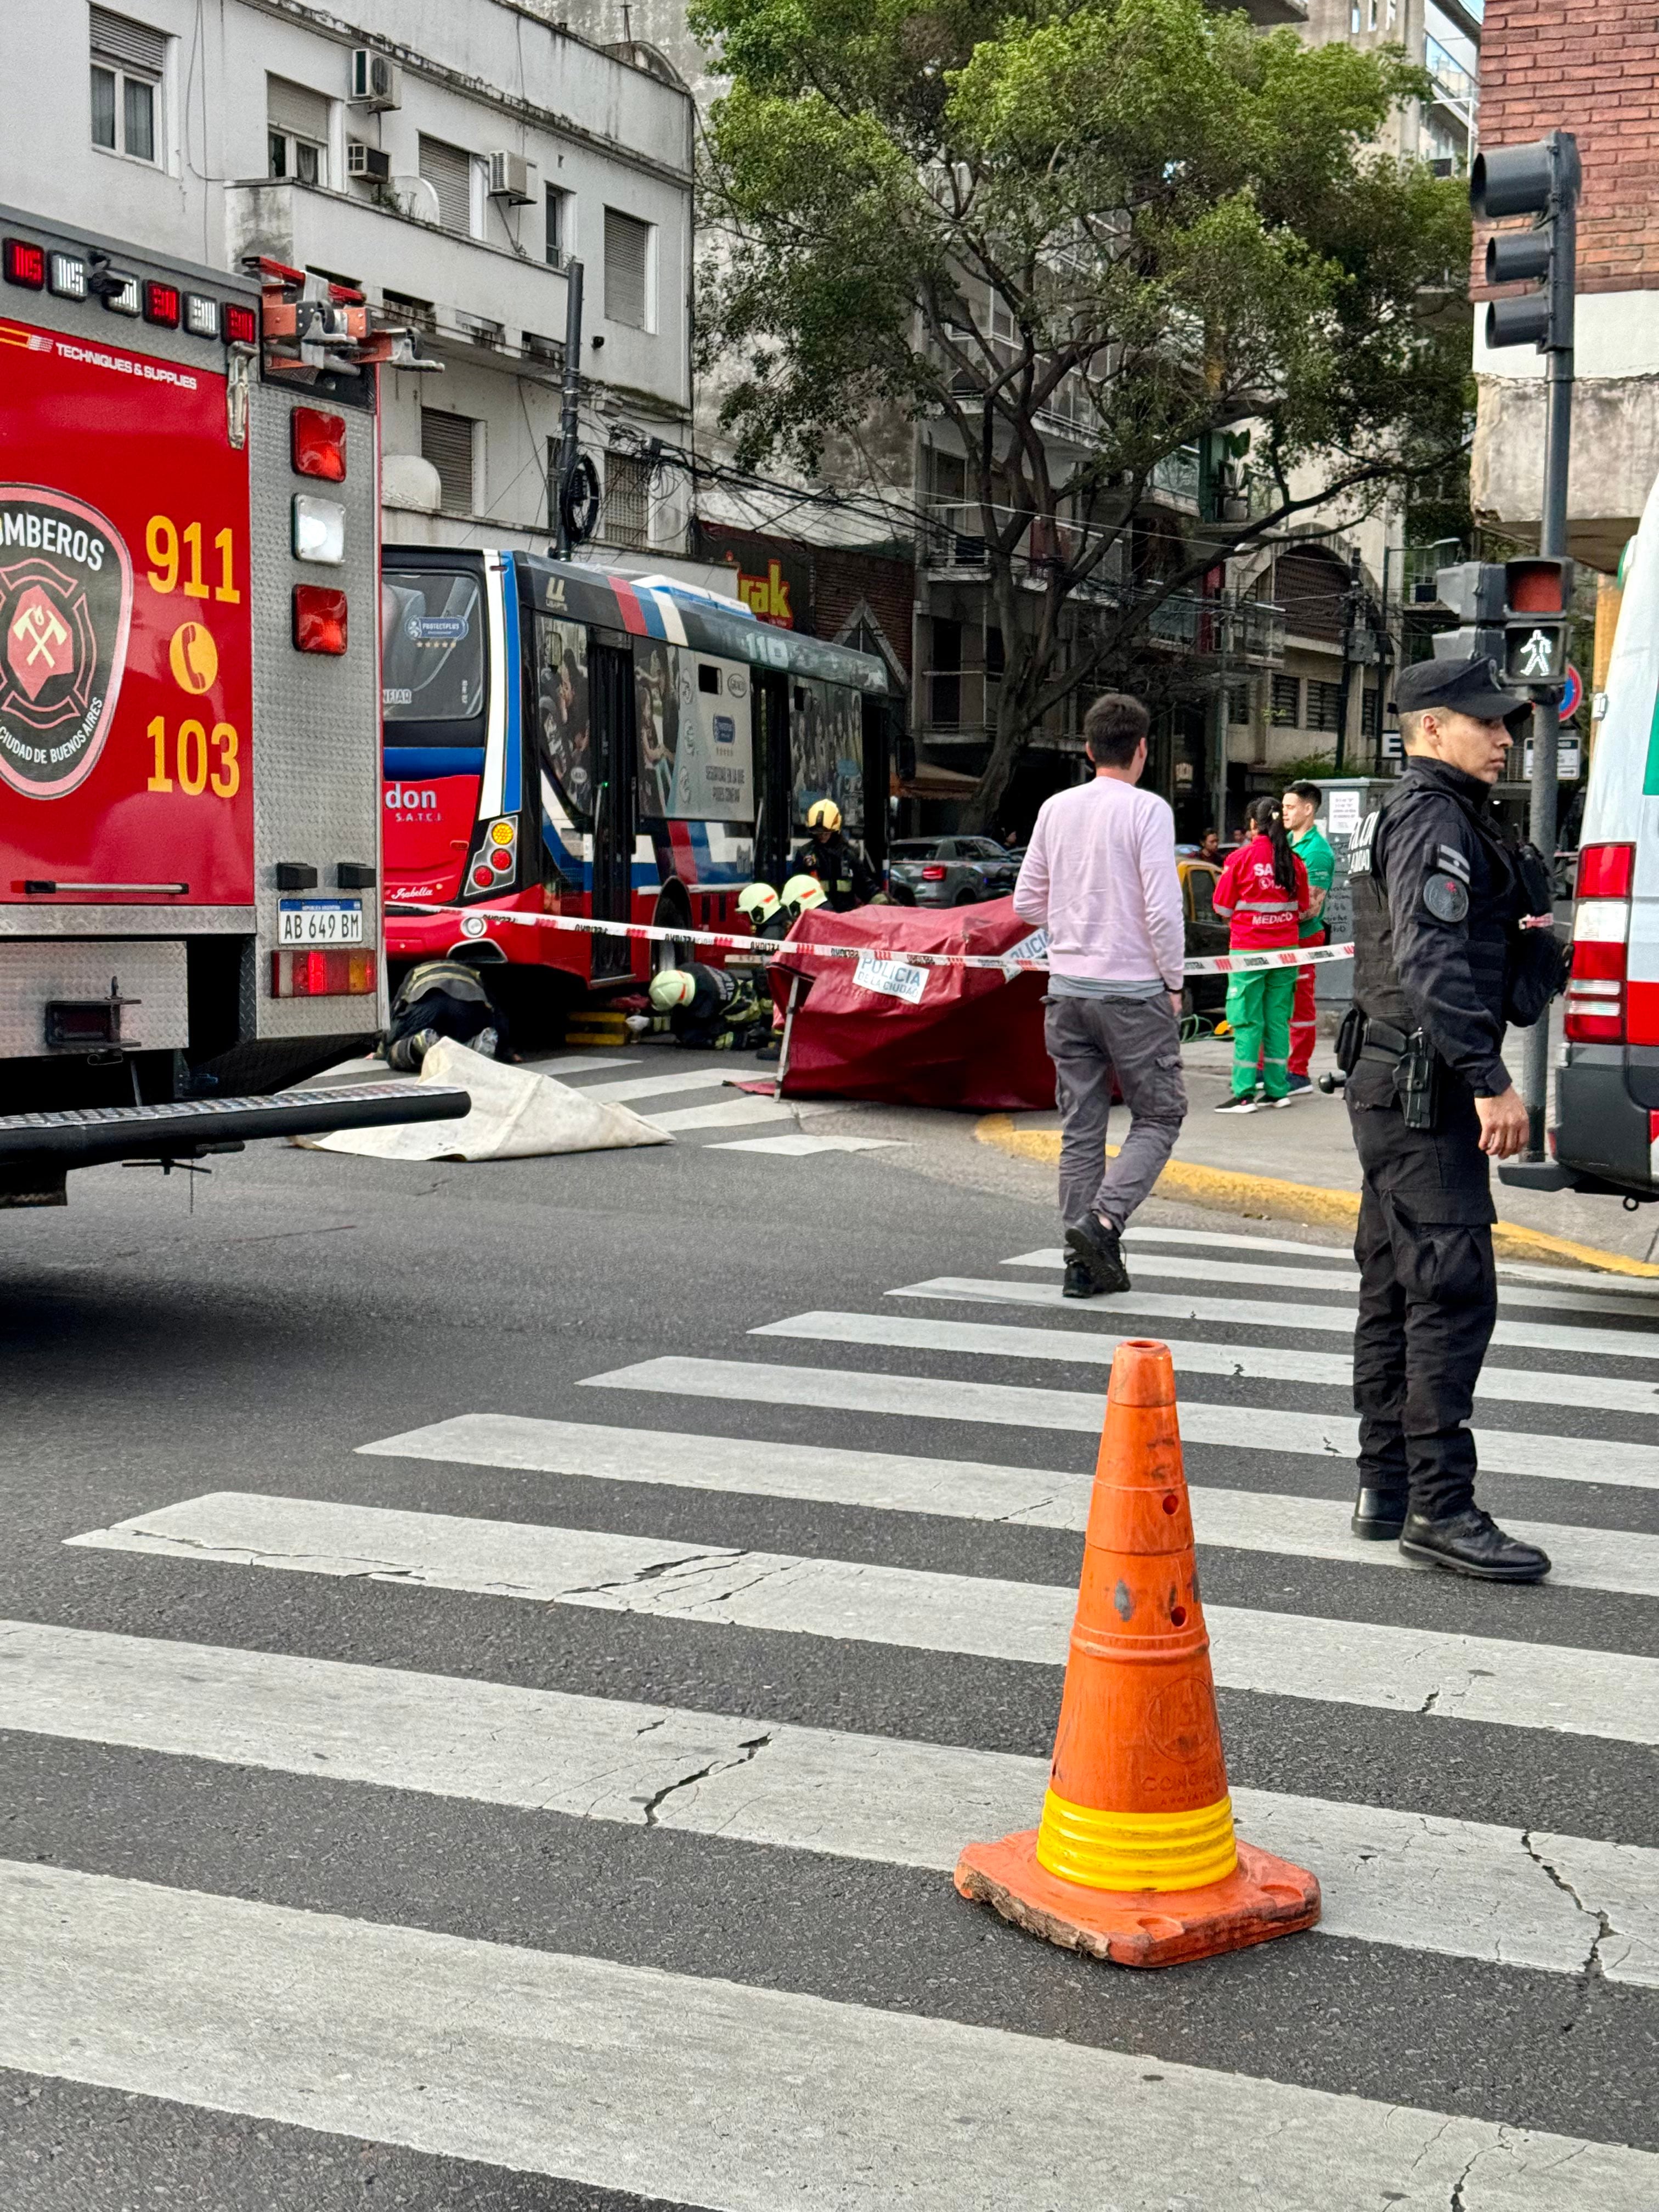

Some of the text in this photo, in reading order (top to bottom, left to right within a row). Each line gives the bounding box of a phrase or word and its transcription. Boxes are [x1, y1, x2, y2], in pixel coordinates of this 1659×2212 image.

[55, 342, 197, 390] TECHNIQUES & SUPPLIES
[0, 512, 105, 571] MBEROS
[146, 515, 240, 604] 911
[741, 563, 791, 618] rak
[746, 633, 789, 668] 110
[0, 697, 103, 764] CIUDAD DE BUENOS AIRES
[146, 715, 240, 798] 103
[1253, 863, 1274, 877] SA
[284, 914, 358, 939] AB 649 BM
[1010, 931, 1050, 959] LICI
[857, 971, 869, 984] DE
[883, 980, 919, 998] CIUDAD
[861, 957, 921, 986] POLICIA
